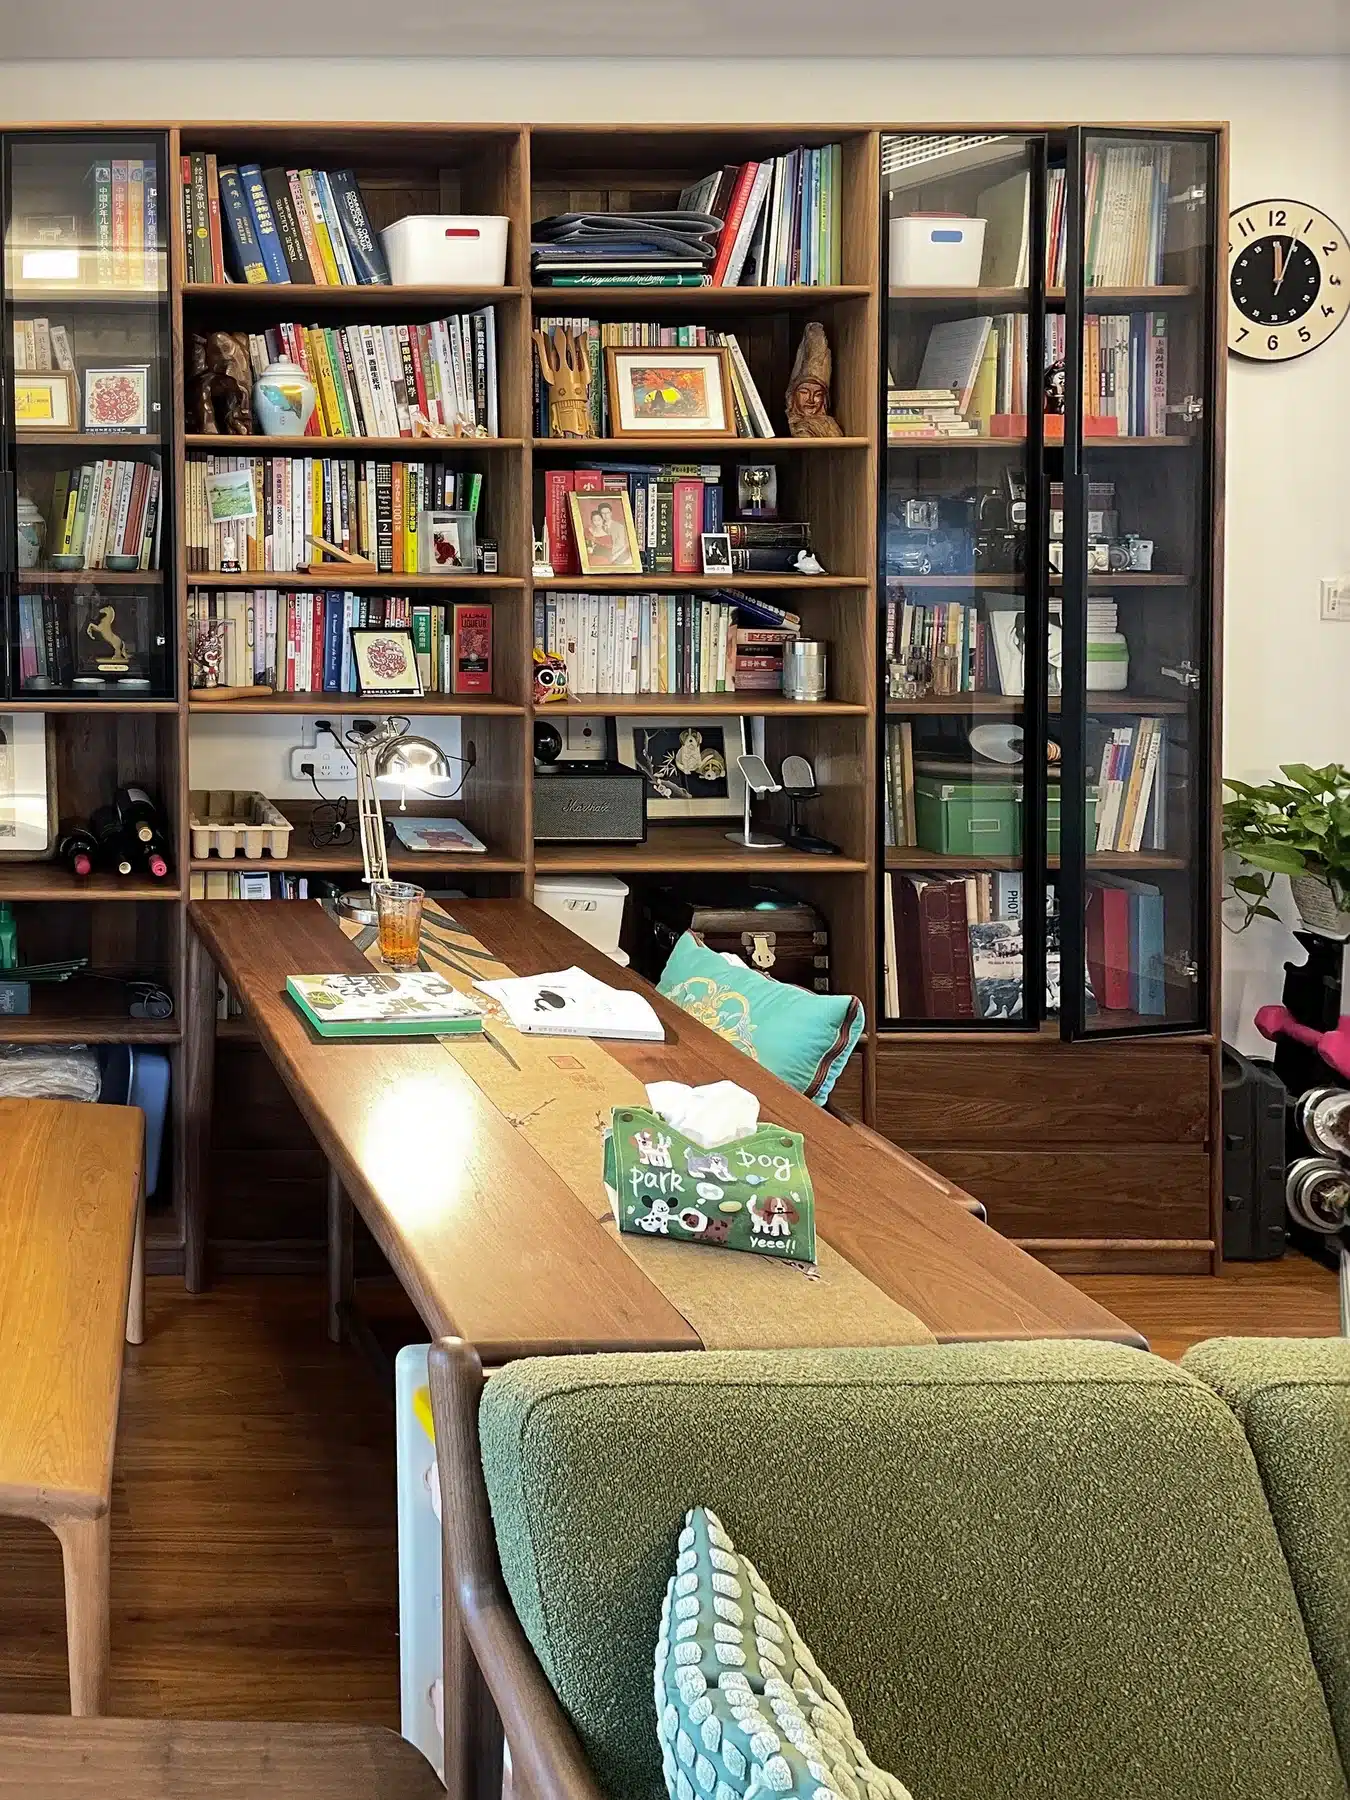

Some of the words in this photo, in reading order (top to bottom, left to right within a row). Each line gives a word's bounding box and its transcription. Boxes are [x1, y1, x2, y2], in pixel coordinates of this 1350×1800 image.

[275, 198, 290, 233] CULTURE
[345, 191, 358, 227] PRODUCTION
[356, 228, 368, 251] MANUAL
[350, 191, 366, 227] COMMERCIAL
[363, 228, 374, 252] CHICKEN
[1269, 210, 1286, 227] 12
[147, 187, 157, 262] 少年儿童百科全书
[1237, 217, 1255, 237] 11
[1303, 219, 1313, 233] 1
[284, 236, 298, 262] TISSUE
[1322, 241, 1338, 256] 2
[1329, 274, 1341, 286] 3
[1321, 304, 1335, 318] 4
[1235, 327, 1250, 343] 7
[1298, 326, 1311, 342] 5
[365, 340, 374, 356] 图解
[1267, 335, 1279, 350] 6
[368, 359, 381, 391] 西藏生死书
[404, 363, 417, 398] 经济学
[583, 482, 595, 491] 小
[382, 523, 389, 531] 2
[684, 494, 695, 549] 现代汉语词典
[462, 619, 487, 628] LIQUEUR
[561, 797, 609, 812] Marshall
[735, 1148, 795, 1181] Dog
[629, 1165, 686, 1197] park
